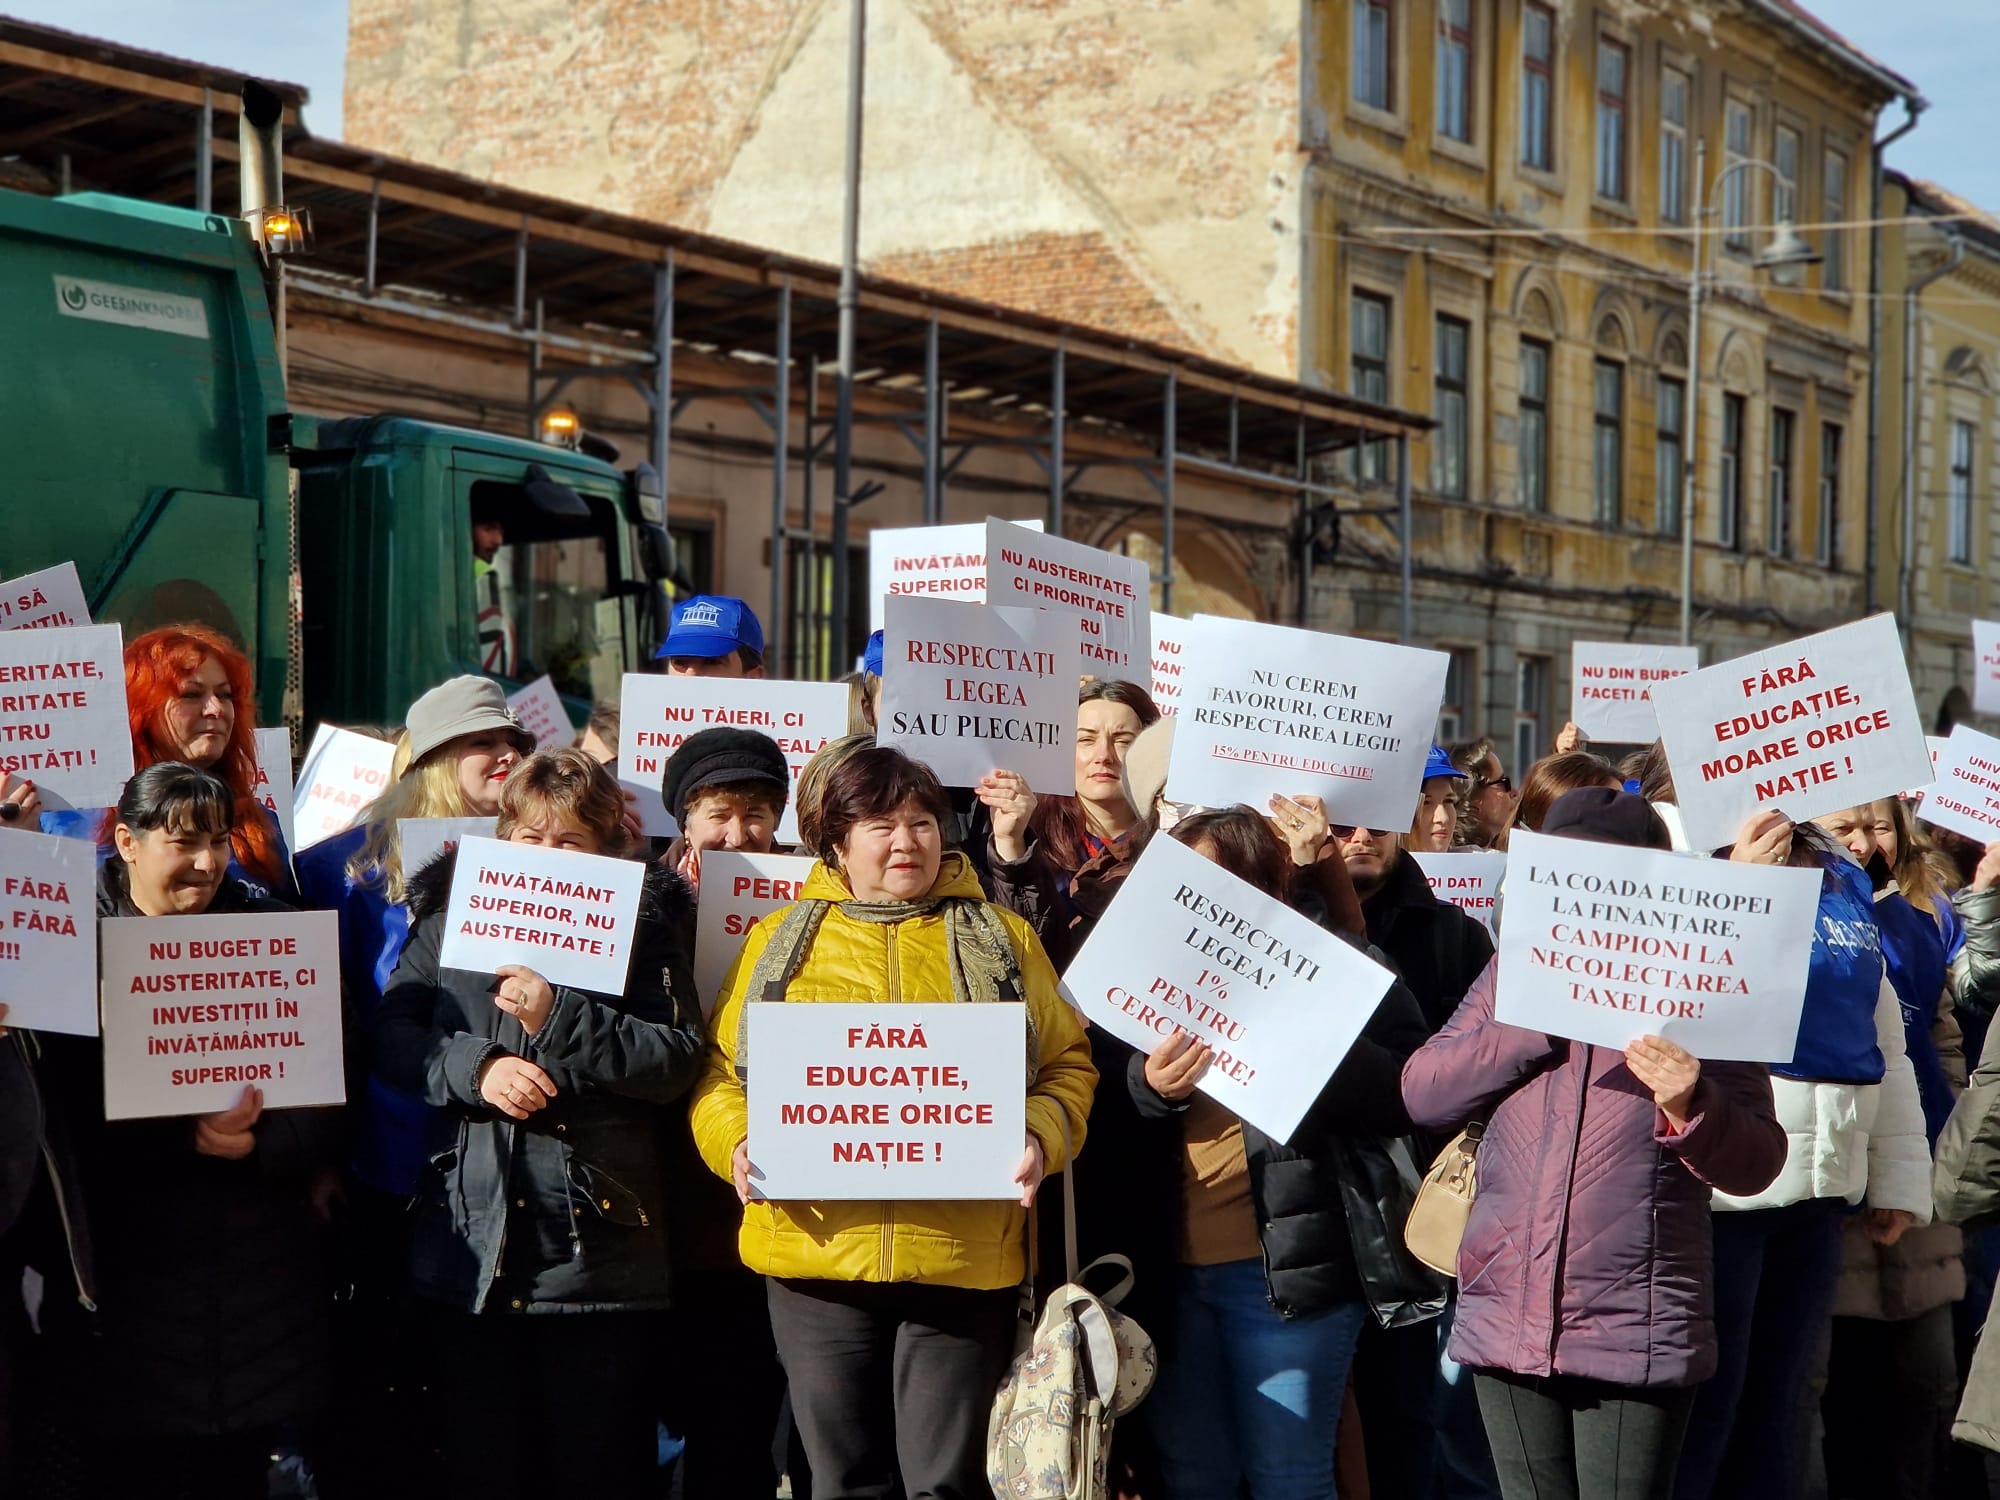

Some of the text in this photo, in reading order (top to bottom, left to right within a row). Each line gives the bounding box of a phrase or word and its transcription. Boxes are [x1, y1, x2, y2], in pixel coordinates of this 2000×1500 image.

[1001, 549, 1137, 601] NU AUSTERITATE,
[18, 588, 48, 611] SĂ
[1014, 577, 1125, 619] CI PRIORITATE
[906, 639, 1056, 680] RESPECTAȚI
[1158, 640, 1182, 655] NU
[1251, 669, 1359, 701] NU CEREM
[1582, 666, 1689, 681] NU DIN BURS
[1742, 656, 1817, 698] FĂRĂ
[0, 691, 87, 713] RITATE
[945, 678, 1028, 707] LEGEA
[1211, 687, 1393, 729] FAVORURI, CEREM
[1582, 687, 1635, 703] FACEȚI
[665, 706, 804, 729] NU TĂIERI, CI
[891, 711, 1060, 748] SAU PLECAȚI!
[1714, 684, 1861, 743] EDUCAȚIE,
[0, 723, 50, 743] TRU
[1194, 707, 1401, 753] RESPECTAREA LEGII!
[1700, 709, 1891, 783] MOARE ORICE
[636, 755, 657, 773] ÎN
[1212, 743, 1240, 759] 15%
[1243, 748, 1299, 768] PENTRU
[1754, 756, 1855, 802] NAȚIE !
[5, 876, 70, 905] FĂRĂ
[478, 867, 616, 905] ÎNVĂȚĂMÂNT
[1447, 877, 1483, 892] DAȚI
[1529, 866, 1773, 915] LA COADA EUROPEI
[13, 909, 78, 938] FĂRĂ
[468, 894, 616, 931] SUPERIOR, NU
[1552, 897, 1741, 941] LA FINANȚARE,
[149, 937, 297, 960] NU BUGET DE
[460, 920, 616, 958] AUSTERITATE !
[1172, 883, 1322, 984] RESPECTAȚI
[1550, 924, 1735, 967] CAMPIONI LA
[1184, 926, 1276, 992] LEGEA!
[1529, 946, 1750, 995] NECOLECTAREA
[130, 968, 316, 994] AUSTERITATE, CI
[1195, 969, 1231, 1001] 1%
[152, 998, 299, 1029] INVESTIȚII ÎN
[1149, 975, 1248, 1042] PENTRU
[1568, 982, 1705, 1020] TAXELOR!
[147, 1029, 305, 1056] ÎNVĂȚĂMÂNTUL
[847, 1022, 928, 1049] FĂRĂ
[171, 1061, 285, 1086] SUPERIOR !
[806, 1066, 969, 1094] EDUCAȚIE,
[780, 1104, 994, 1125] MOARE ORICE
[832, 1142, 942, 1170] NAȚIE !
